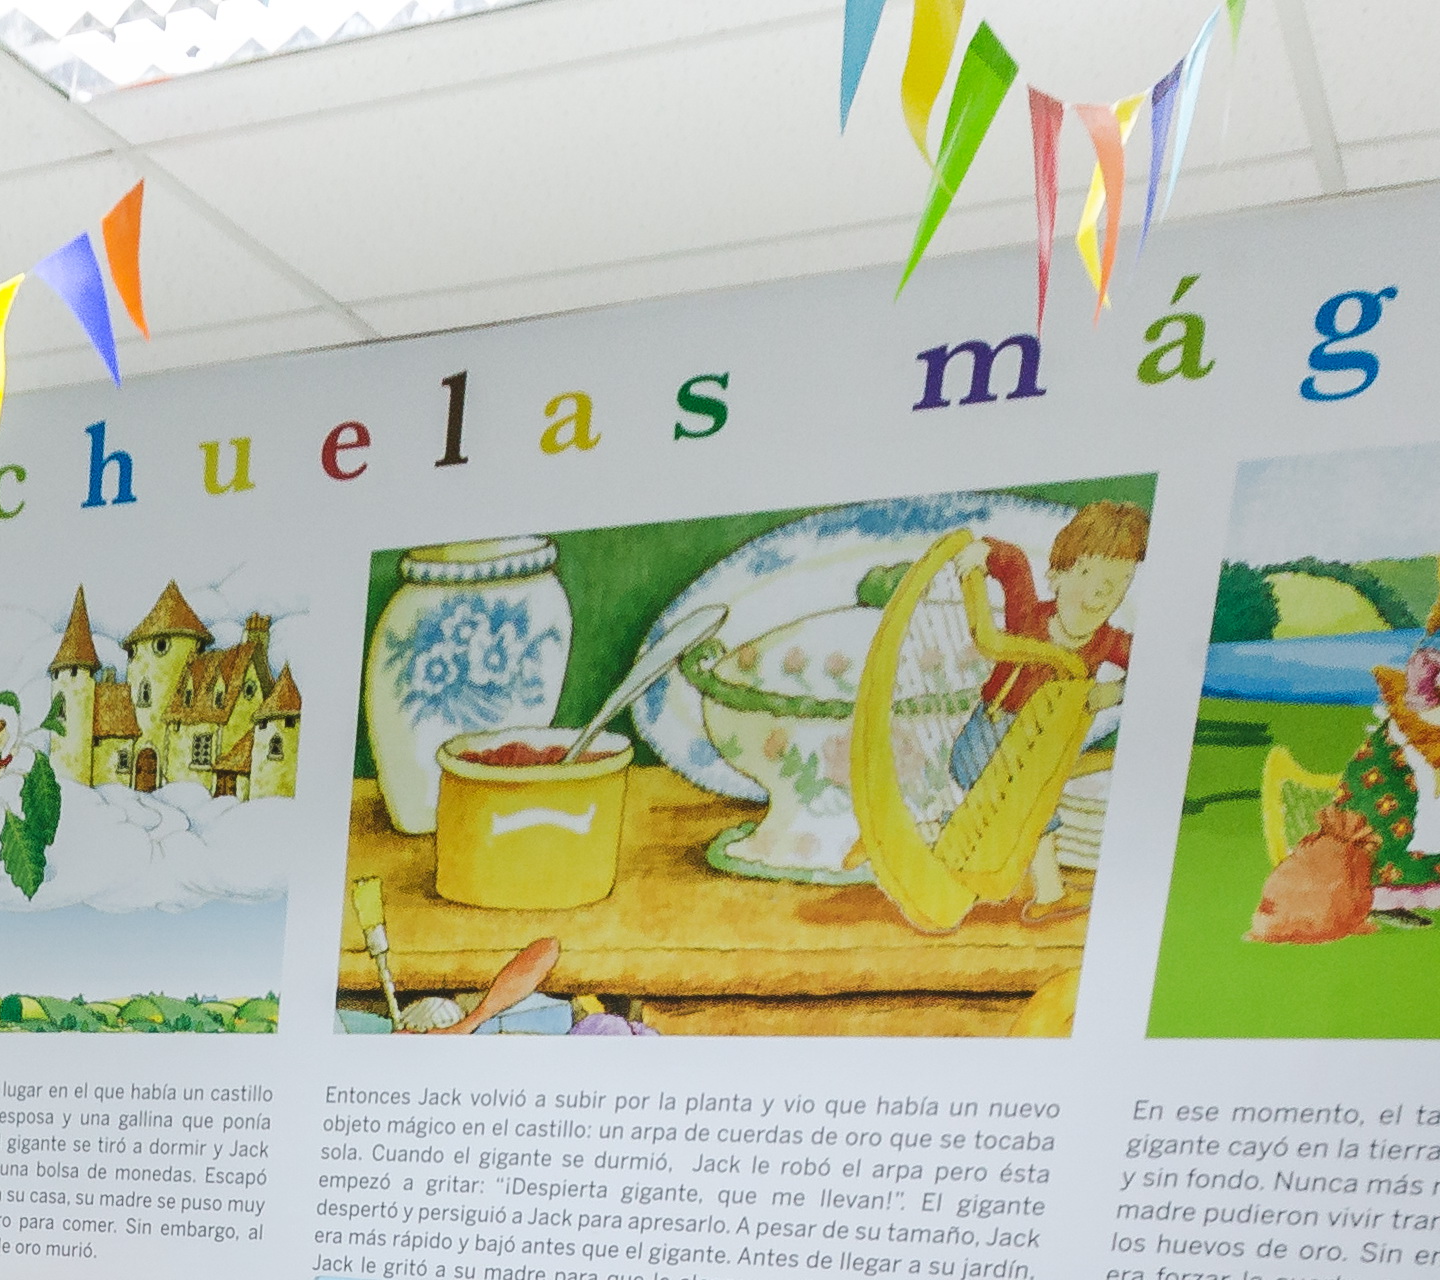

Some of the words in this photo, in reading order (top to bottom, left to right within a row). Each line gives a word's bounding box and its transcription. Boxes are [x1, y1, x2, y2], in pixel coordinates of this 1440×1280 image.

[325, 1085, 411, 1106] Entonces
[417, 1087, 462, 1107] Jack
[470, 1088, 527, 1108] volvió
[534, 1093, 546, 1108] a
[554, 1089, 607, 1109] subir
[614, 1095, 651, 1114] por
[658, 1091, 677, 1111] la
[684, 1092, 753, 1116] planta
[760, 1098, 775, 1118] y
[783, 1094, 816, 1114] vio
[824, 1099, 867, 1119] que
[876, 1095, 939, 1117] había
[949, 1101, 979, 1118] un
[988, 1102, 1061, 1119] nuevo
[0, 1163, 29, 1177] una
[36, 1160, 79, 1179] bolsa
[86, 1162, 108, 1181] de
[114, 1164, 197, 1184] monedas.
[204, 1166, 268, 1190] Escapó
[1116, 1200, 1197, 1222] madre
[1202, 1203, 1319, 1227] pudieron
[1328, 1211, 1384, 1229] vivir
